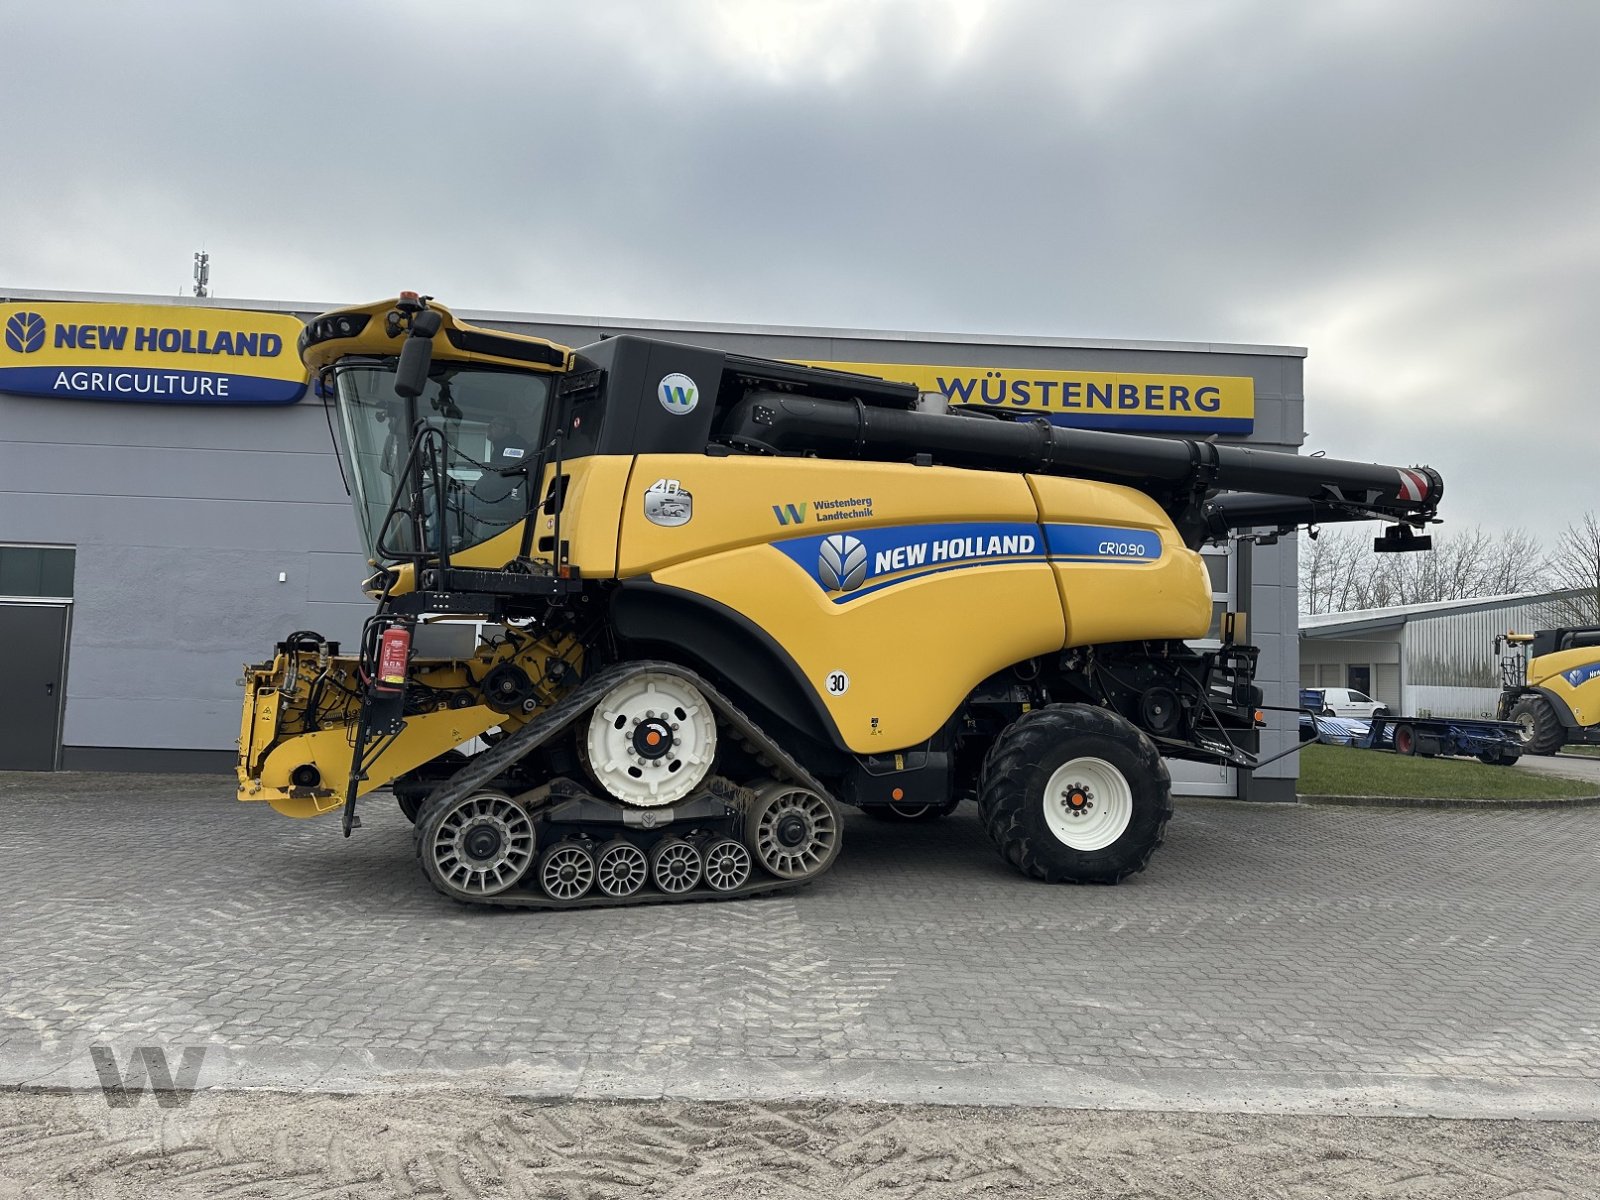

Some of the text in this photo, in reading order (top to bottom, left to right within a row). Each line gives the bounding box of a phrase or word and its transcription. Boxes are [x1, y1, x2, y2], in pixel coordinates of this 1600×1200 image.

[54, 323, 282, 357] NEW HOLLAND
[53, 371, 229, 396] AGRICULTURE
[936, 371, 1221, 412] WÜSTENBERG
[813, 498, 873, 510] Wüstenberg
[816, 508, 873, 522] Landtechnik
[875, 535, 1035, 574] NEW HOLLAND
[1098, 541, 1145, 556] CR10.90
[830, 674, 845, 692] 30
